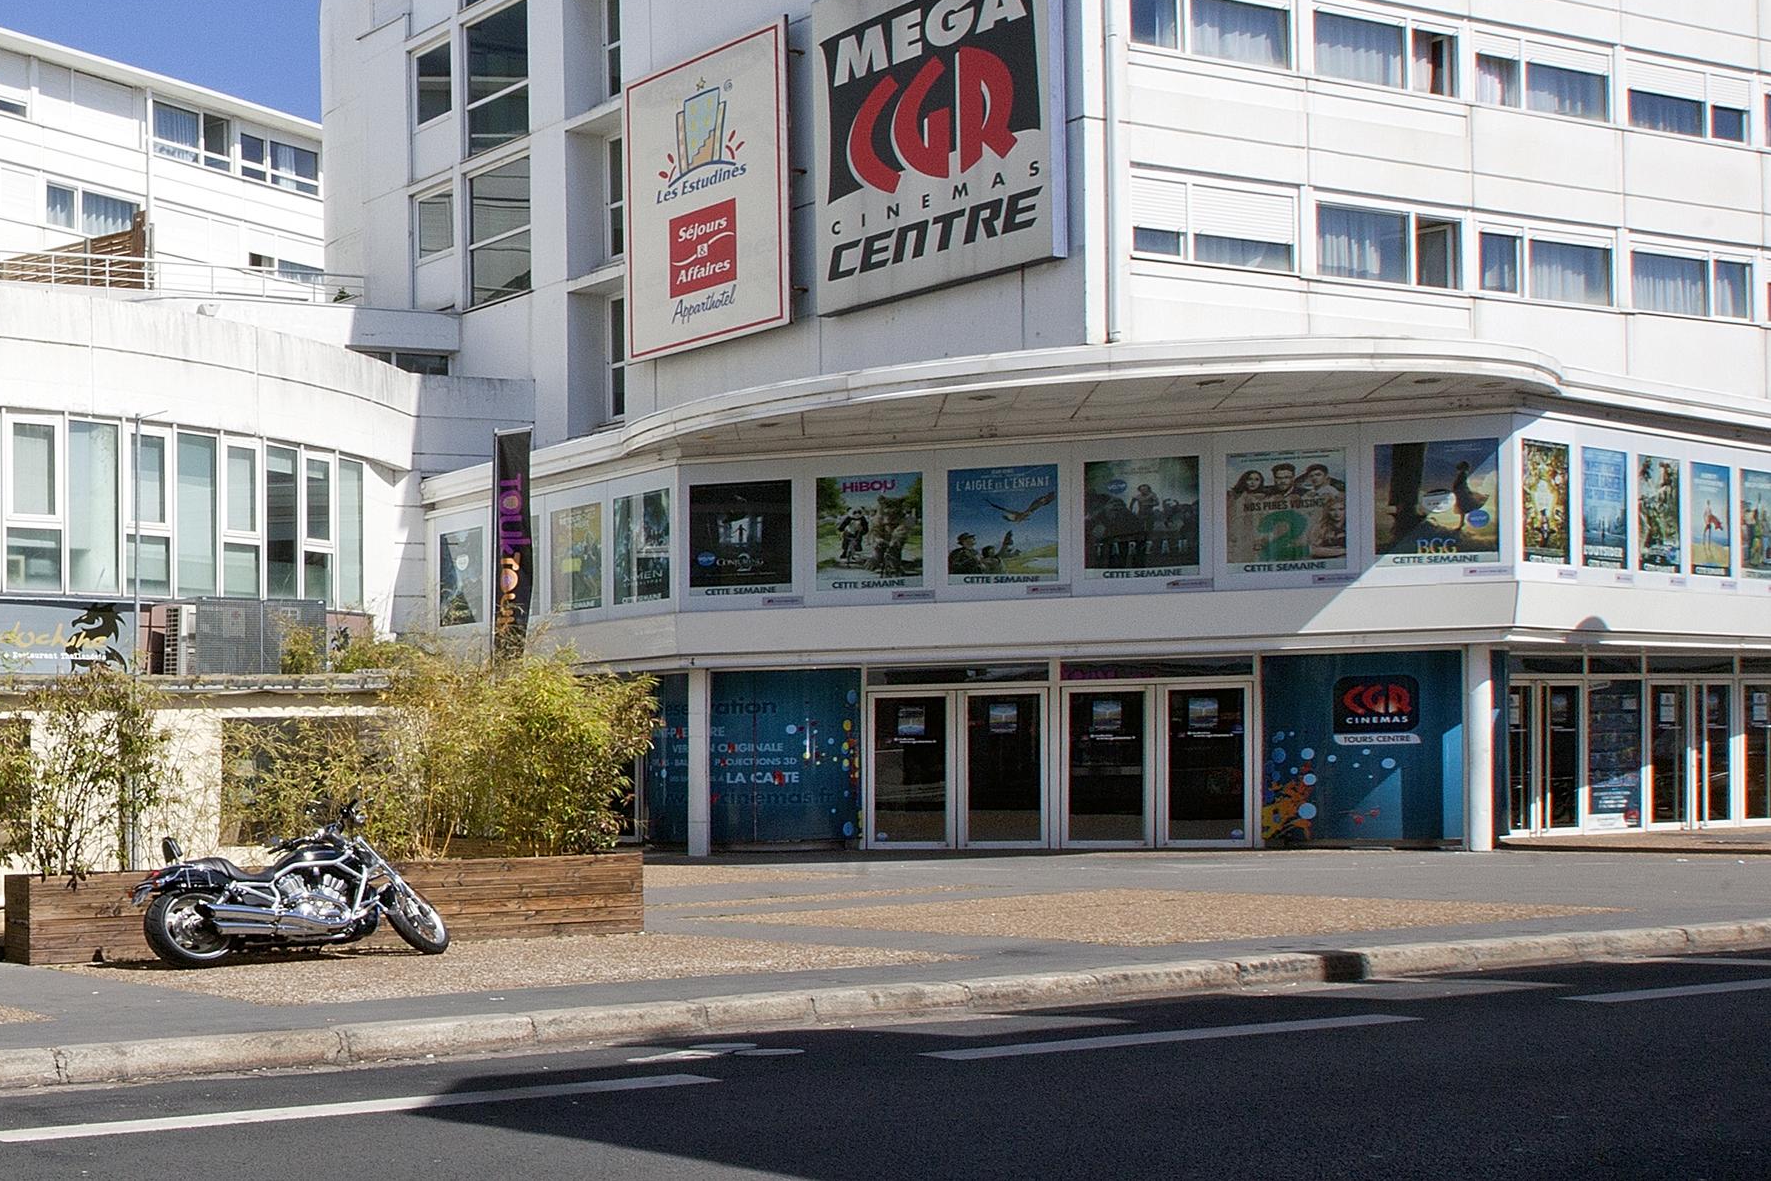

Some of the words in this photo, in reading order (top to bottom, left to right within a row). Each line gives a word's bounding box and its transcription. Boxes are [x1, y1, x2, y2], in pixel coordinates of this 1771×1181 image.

[848, 46, 1018, 194] CGR
[656, 187, 678, 205] Les
[681, 163, 747, 196] Estudines
[831, 160, 1040, 236] CINEMAS
[678, 217, 728, 242] Séjours
[828, 185, 1043, 282] CENTRE
[676, 259, 731, 285] Affaires
[842, 479, 896, 493] HIBOU
[1256, 509, 1312, 562] 2
[1094, 539, 1188, 556] TARZAN
[1392, 556, 1424, 564] CETTE
[1426, 554, 1479, 564] SEMAINE
[1102, 570, 1131, 579] CETTE
[1134, 568, 1183, 578] SEMAINE
[1244, 563, 1273, 572] CETTE
[1276, 561, 1326, 571] SEMAINE
[832, 580, 858, 589] CETTE
[861, 579, 906, 589] SEMAINE
[963, 575, 991, 584] CETTE
[994, 575, 1040, 584] SEMAINE
[705, 587, 731, 596] CETTE
[733, 586, 777, 595] SEMAINE
[1343, 684, 1412, 715] CGR
[1346, 715, 1409, 724] CINEMAS
[1343, 736, 1374, 744] TOURS
[1376, 735, 1411, 743] CENTRE
[726, 772, 747, 784] LA
